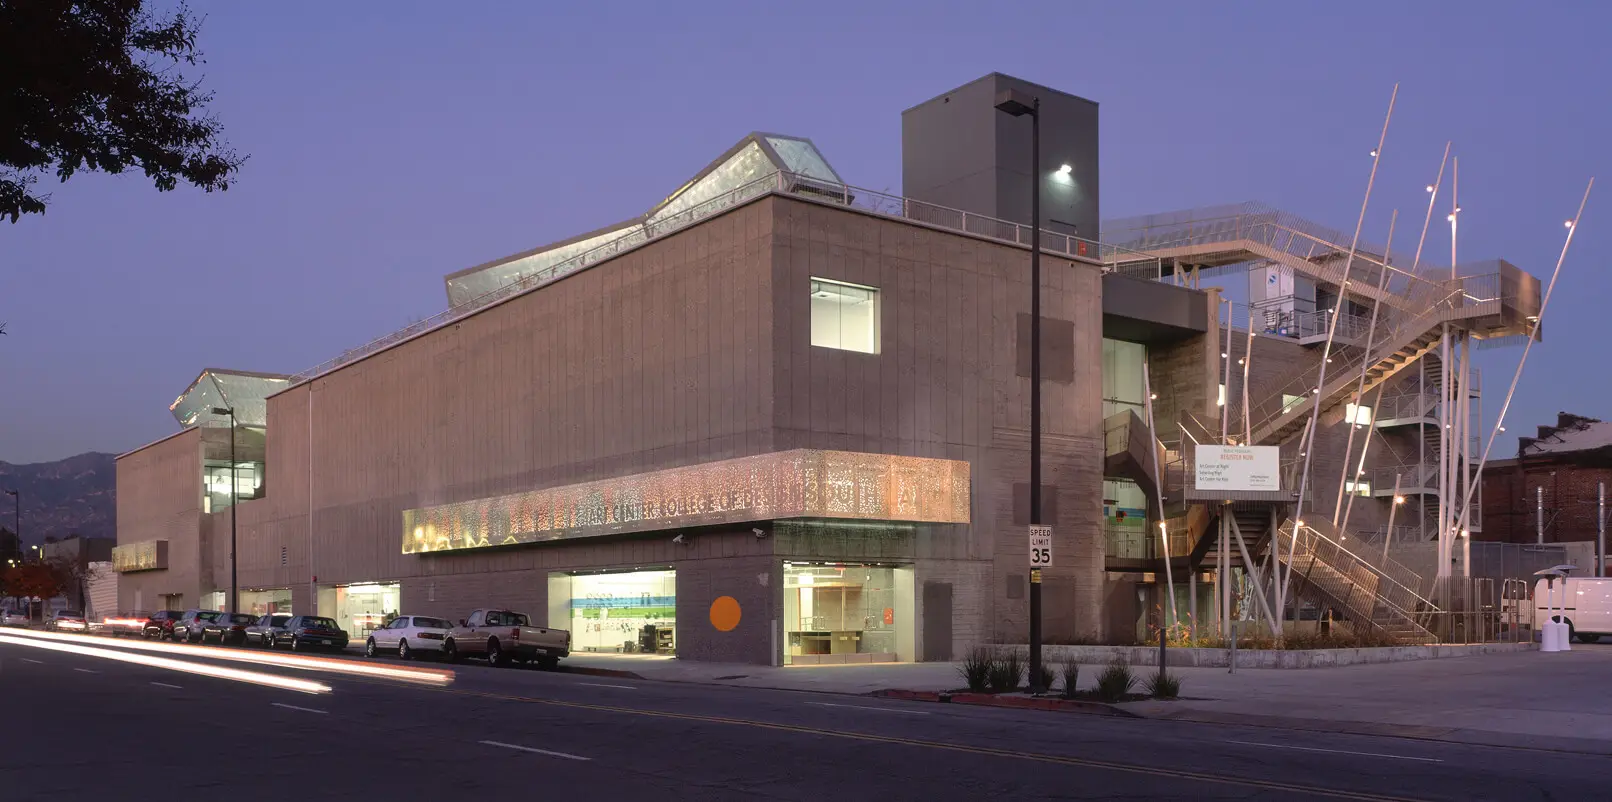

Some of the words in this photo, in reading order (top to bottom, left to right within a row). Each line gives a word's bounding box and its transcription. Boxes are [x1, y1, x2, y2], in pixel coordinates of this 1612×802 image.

[589, 506, 609, 525] ART
[613, 499, 655, 522] CENTER
[659, 493, 717, 517] COLLEGE
[1032, 548, 1050, 563] 35
